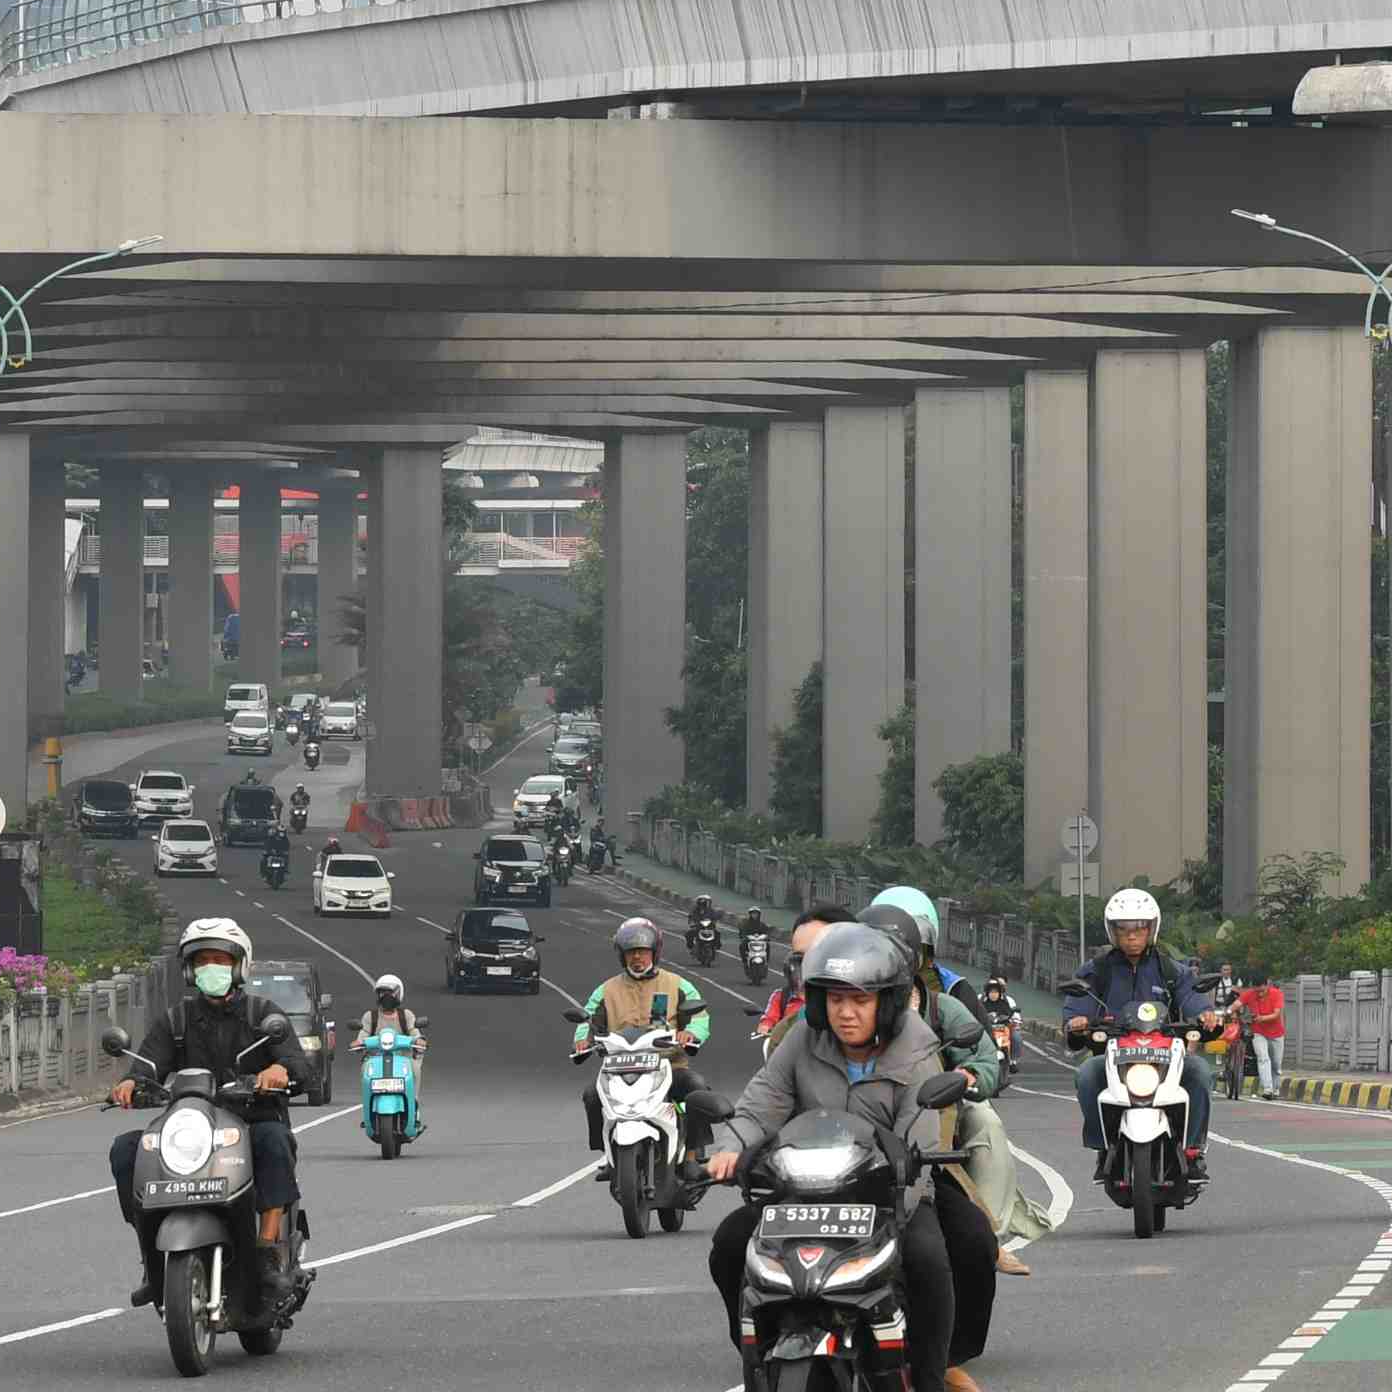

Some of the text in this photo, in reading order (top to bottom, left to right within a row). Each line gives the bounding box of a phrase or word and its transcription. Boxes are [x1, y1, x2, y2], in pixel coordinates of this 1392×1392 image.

[149, 1184, 157, 1194] B
[765, 1208, 776, 1221] B
[786, 1207, 830, 1221] 5337
